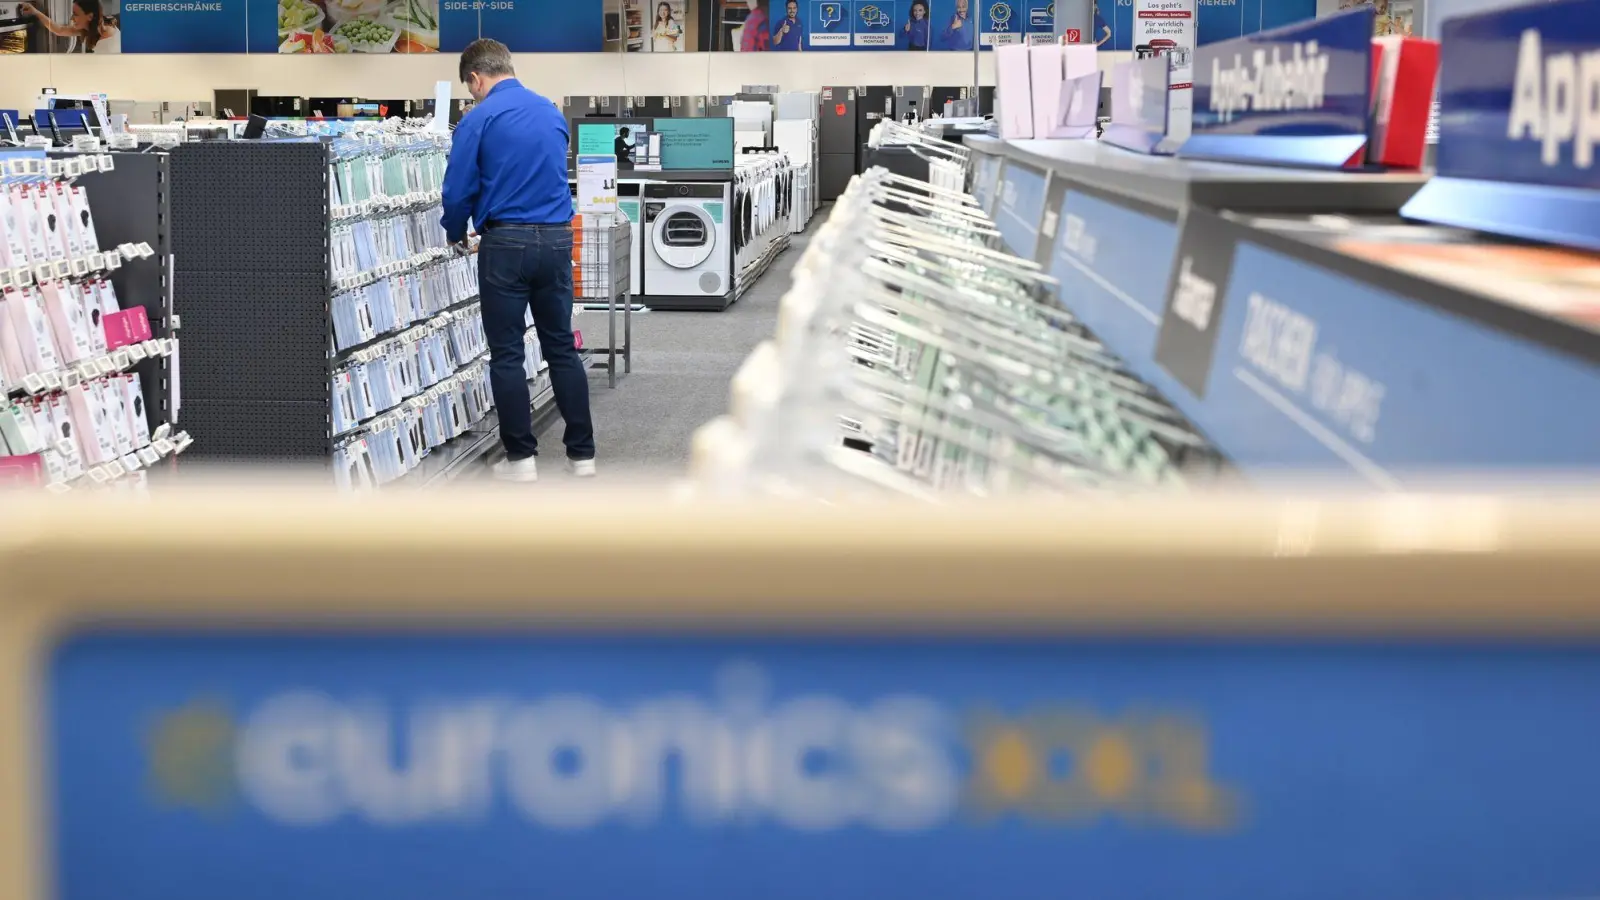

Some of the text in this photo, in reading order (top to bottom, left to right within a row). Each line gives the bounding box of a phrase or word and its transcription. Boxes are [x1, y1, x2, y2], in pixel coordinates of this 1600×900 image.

[125, 1, 222, 11] GEFRIERSCHRÄNKE
[444, 1, 514, 10] SIDE-BY-SIDE
[1161, 2, 1182, 10] geht's
[1210, 39, 1330, 123] Apple-Zubehör
[236, 658, 956, 832] euronics
